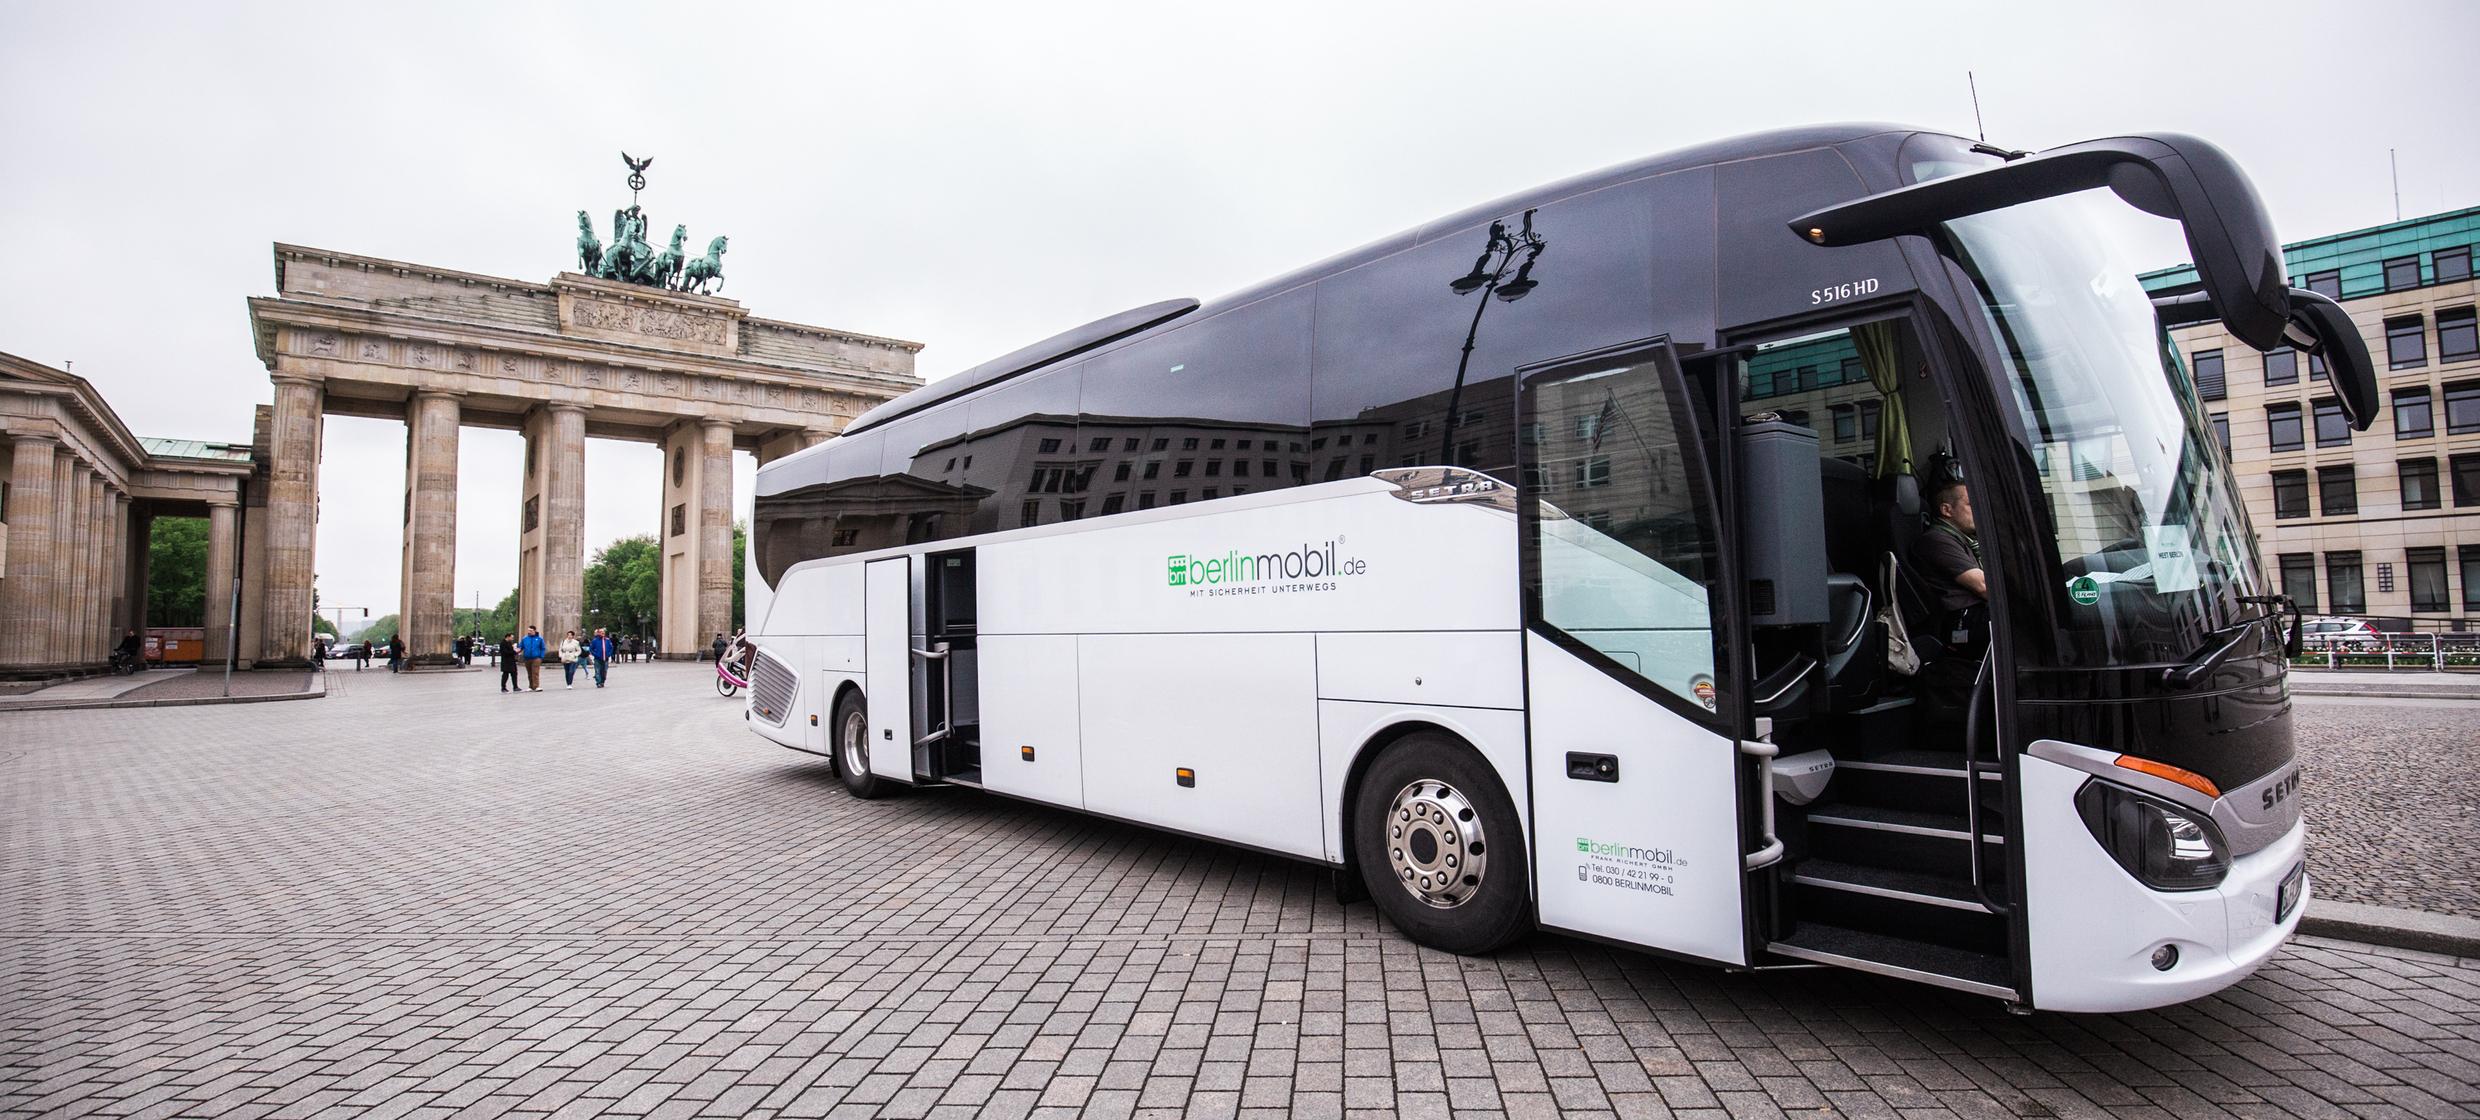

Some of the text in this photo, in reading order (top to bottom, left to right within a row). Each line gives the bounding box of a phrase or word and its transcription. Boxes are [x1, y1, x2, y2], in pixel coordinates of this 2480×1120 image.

[1811, 278, 1879, 305] S 516 HD
[1411, 480, 1493, 499] SETRA
[1190, 582, 1337, 598] MIT SICHERHEIT UNTERWEGS
[1590, 839, 1688, 866] berlinmobil.de
[1591, 854, 1613, 862] FRANK
[1592, 863, 1605, 873] Tel.
[1606, 865, 1620, 875] 030
[1627, 869, 1637, 878] 42
[1638, 870, 1647, 879] 21
[1649, 872, 1660, 881] 99
[1667, 875, 1674, 884] 0
[1592, 874, 1674, 896] 0800 BERLINMOBIL
